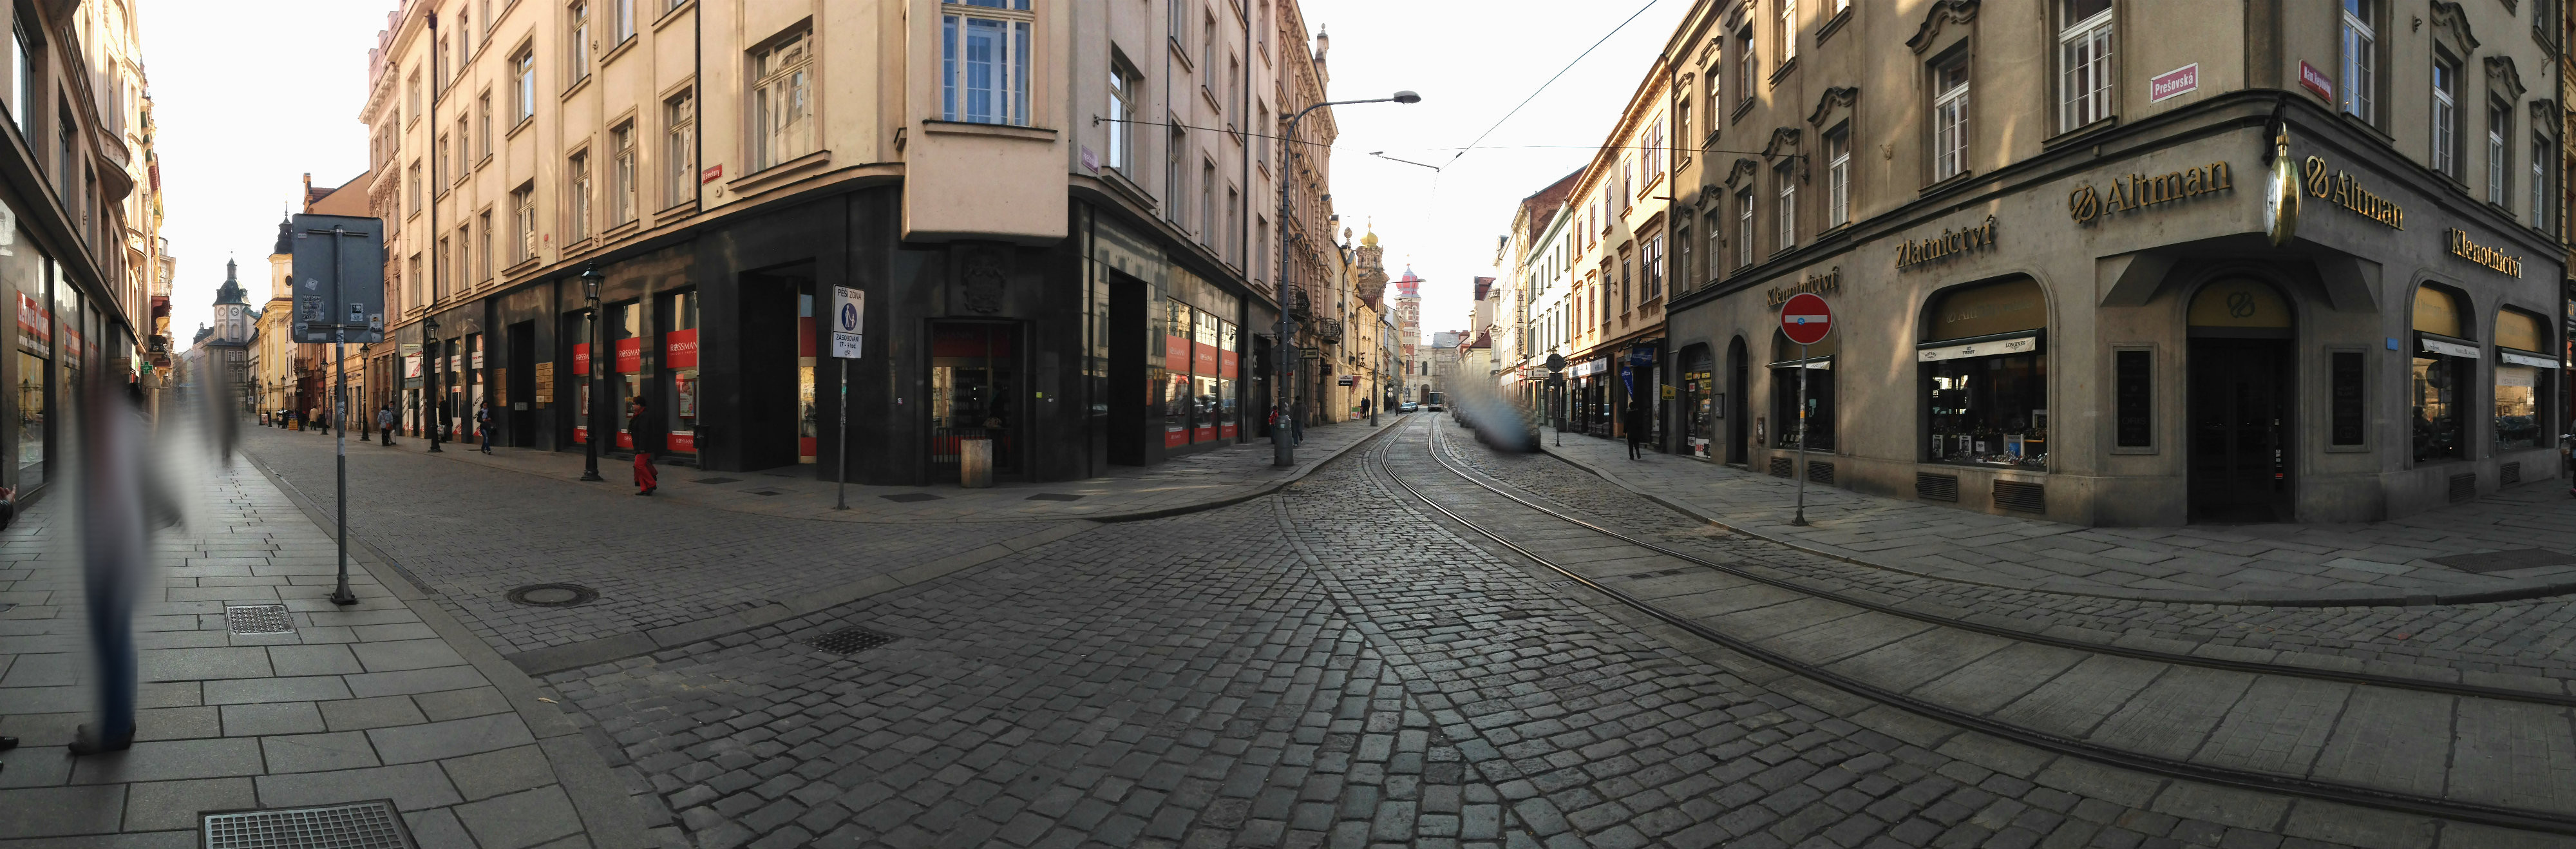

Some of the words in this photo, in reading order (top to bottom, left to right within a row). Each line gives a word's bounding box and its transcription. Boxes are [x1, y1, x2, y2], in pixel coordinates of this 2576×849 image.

[2155, 72, 2193, 96] Prešovská
[2101, 160, 2232, 216] Altman
[2332, 169, 2404, 231] Altman
[1895, 215, 1994, 269] Zlatnictví
[2450, 227, 2523, 279] Klenotnictví
[849, 291, 862, 300] ZÓNA
[836, 334, 860, 342] ZÁSOBOVÁNÍ
[2005, 341, 2026, 351] LONGINES
